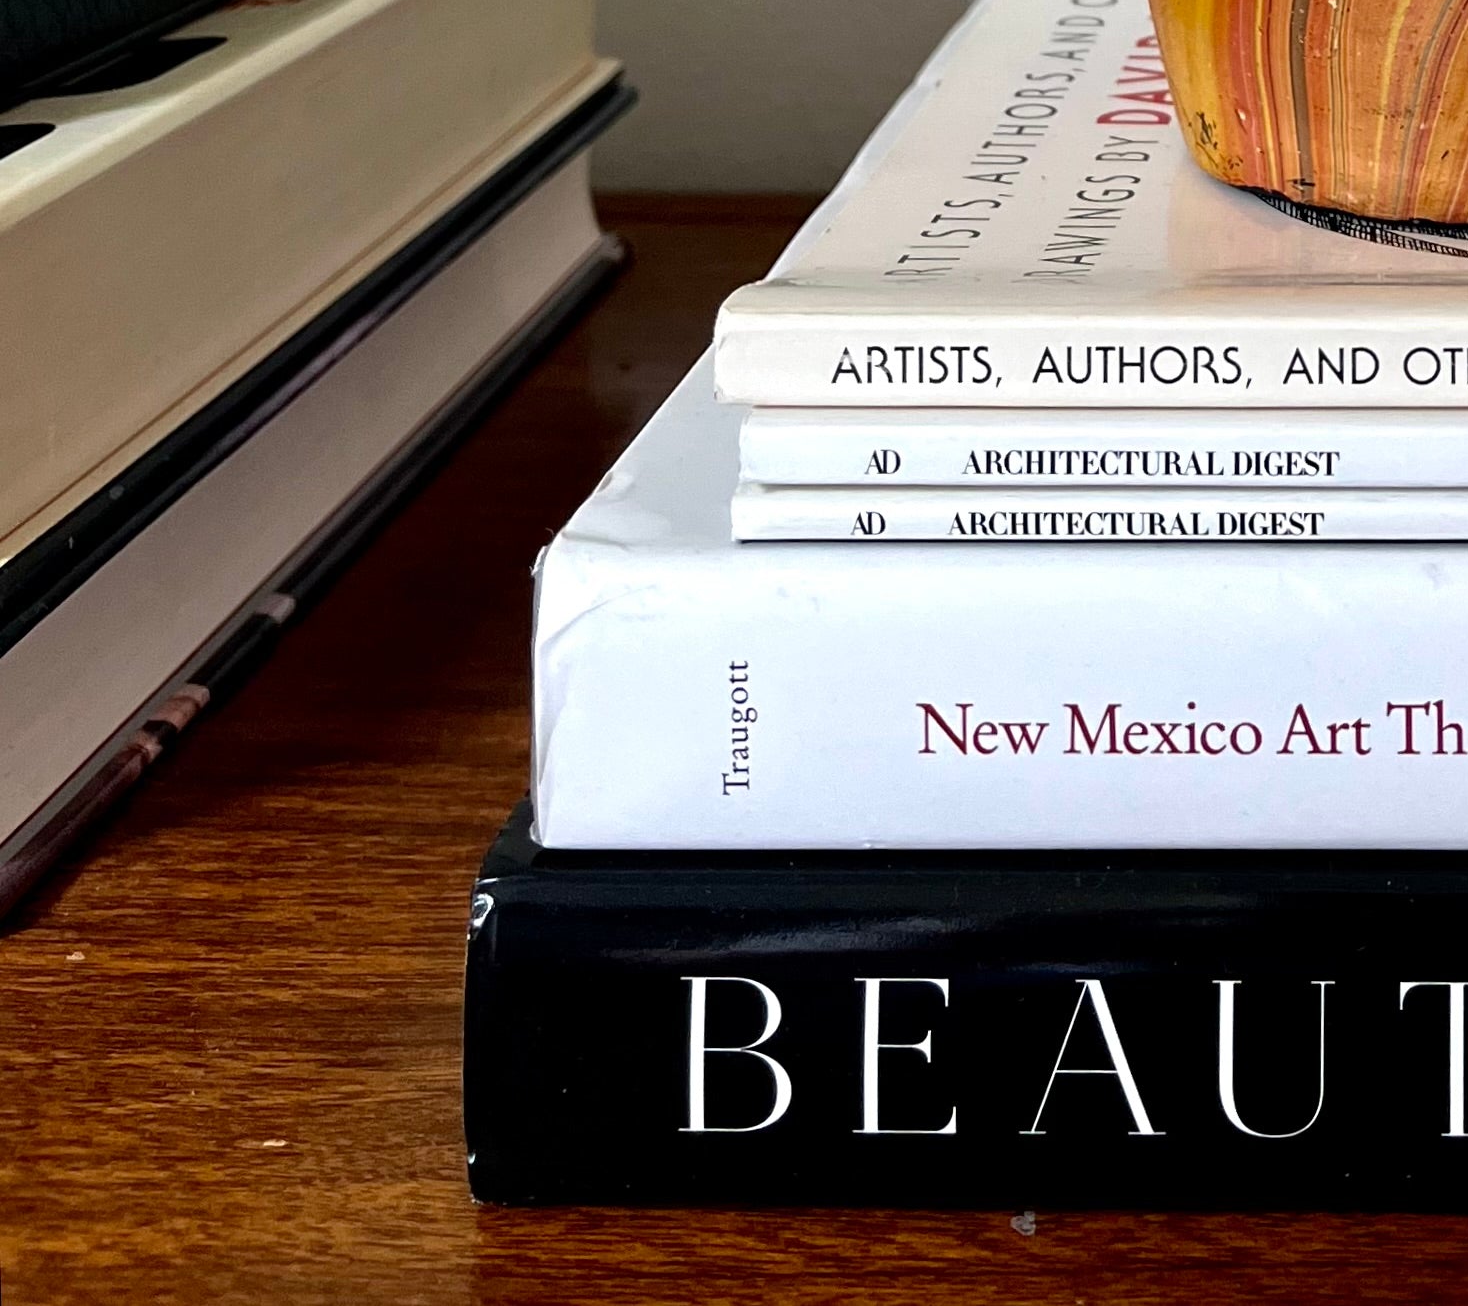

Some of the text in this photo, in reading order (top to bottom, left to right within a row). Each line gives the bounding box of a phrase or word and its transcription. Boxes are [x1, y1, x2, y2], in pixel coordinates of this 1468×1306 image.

[882, 193, 1015, 283] RTISTS,
[962, 67, 1088, 185] AUTHORS,
[1040, 13, 1106, 63] AND
[1012, 174, 1142, 285] RAWINGS
[1094, 134, 1160, 163] BY
[832, 346, 1002, 388] ARTISTS,
[1032, 346, 1252, 388] AUTHORS,
[1283, 346, 1380, 385] AND
[863, 449, 901, 476] AD
[961, 449, 1341, 478] ARCHITECTURAL DIGEST
[850, 510, 887, 537] AD
[947, 510, 1326, 538] ARCHITECTURAL DIGEST
[722, 660, 758, 796] Traugott
[915, 702, 1051, 756] New
[1062, 700, 1264, 757] Mexico
[1276, 702, 1372, 756] Art
